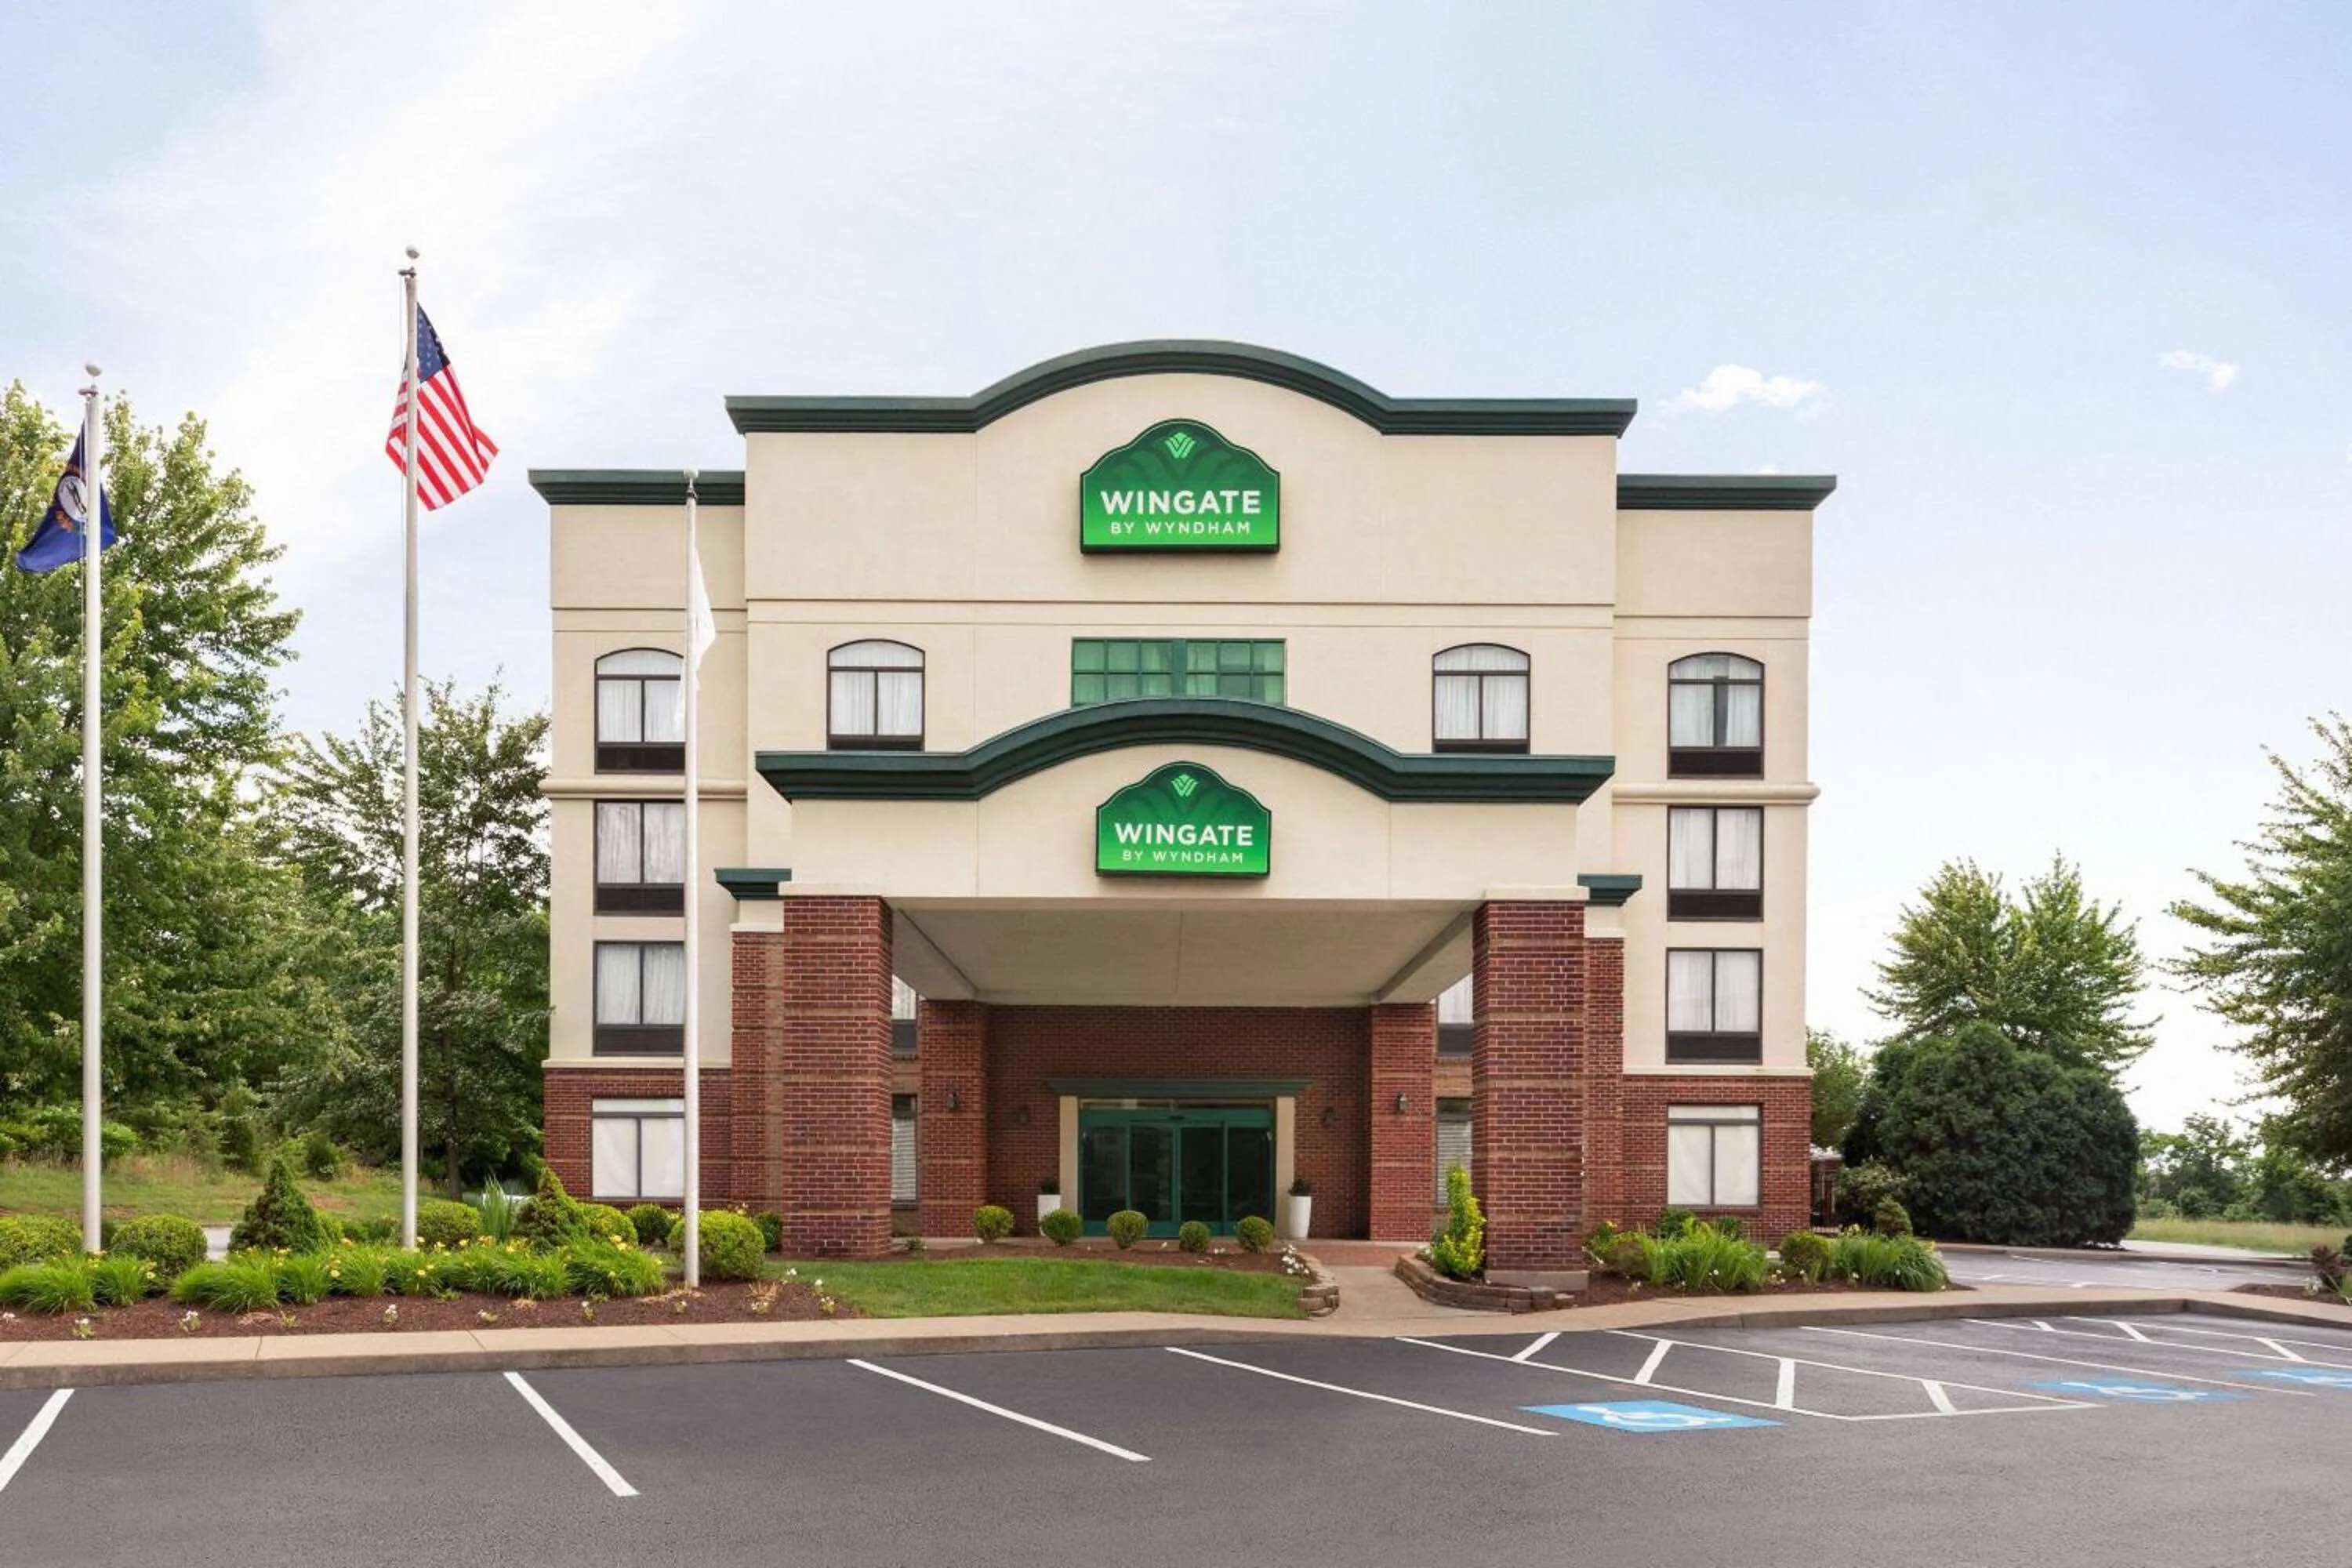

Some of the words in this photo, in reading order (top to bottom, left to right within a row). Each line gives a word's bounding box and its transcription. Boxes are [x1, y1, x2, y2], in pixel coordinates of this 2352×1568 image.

[1101, 490, 1261, 514] WINGATE
[1111, 522, 1134, 534] BY
[1146, 522, 1250, 534] WYNDHAM
[1115, 823, 1253, 846] WINGATE
[1123, 850, 1143, 861] BY
[1153, 851, 1243, 863] WYNDHAM
